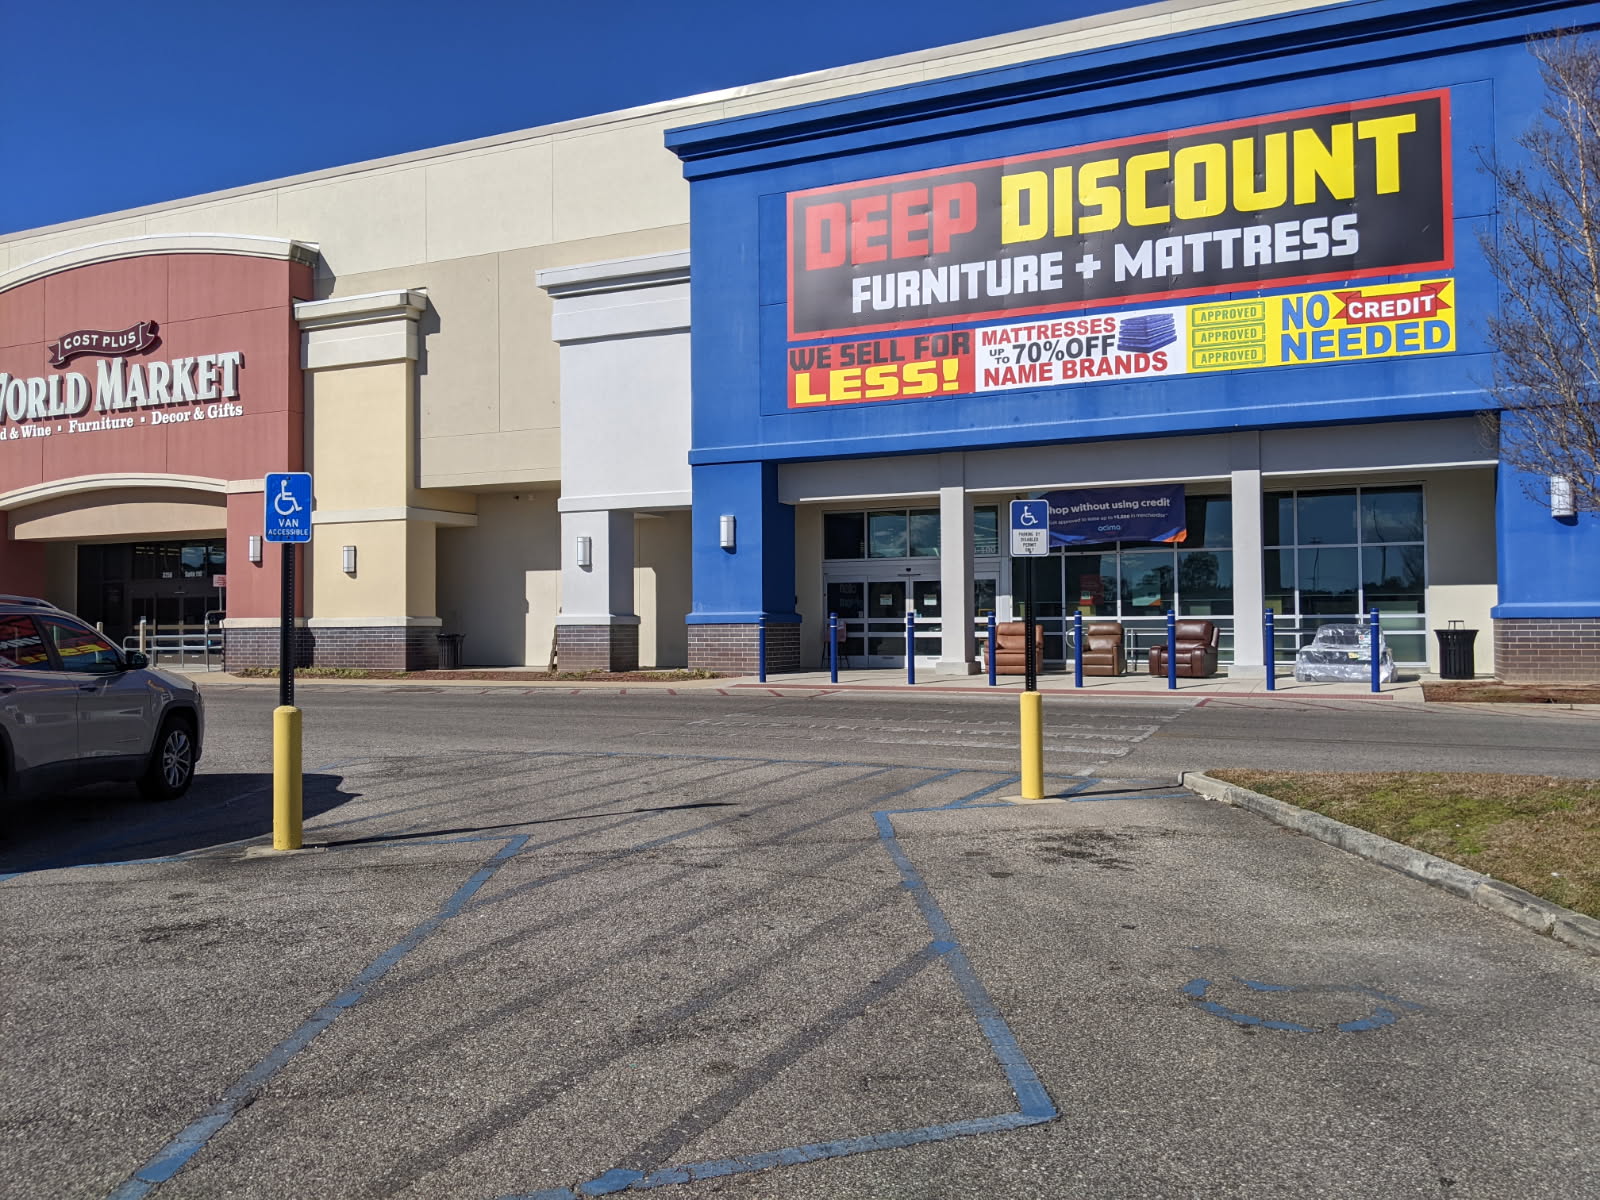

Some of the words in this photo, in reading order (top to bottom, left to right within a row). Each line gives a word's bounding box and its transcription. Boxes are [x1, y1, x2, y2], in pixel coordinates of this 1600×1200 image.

[805, 181, 977, 271] DEEP
[1001, 113, 1417, 245] DISCOUNT
[852, 251, 1063, 313] FURNITURE
[1075, 254, 1101, 279] +
[1114, 213, 1360, 283] MATTRESS
[1200, 308, 1257, 322] APPROVED
[1281, 293, 1330, 331] NO
[1347, 293, 1437, 320] CREDIT
[63, 334, 99, 350] COST
[102, 332, 137, 348] PLUS
[981, 317, 1116, 346] MATTRESSES
[1200, 329, 1257, 343] APPROVED
[1280, 319, 1451, 362] NEEDED
[789, 346, 832, 371] WE
[840, 339, 906, 367] SELL
[914, 332, 971, 360] FOR
[989, 348, 1005, 359] UP
[994, 356, 1010, 365] TO
[1200, 349, 1258, 364] APPROVED
[984, 361, 1053, 387] NAME
[1062, 351, 1169, 380] BRANDS
[94, 351, 241, 411] MARKET
[795, 358, 959, 404] LESS!
[9, 426, 19, 439] &
[21, 424, 52, 438] Wine
[68, 415, 134, 433] Furniture
[151, 410, 191, 425] Decor
[193, 406, 205, 420] &
[207, 404, 243, 419] Gifts
[1049, 506, 1070, 516] hop
[1070, 502, 1110, 512] without
[1111, 500, 1139, 509] using
[1141, 498, 1171, 507] credit
[267, 528, 309, 536] ACCESSIBLE
[278, 518, 299, 528] VAN
[1097, 524, 1121, 532] acima
